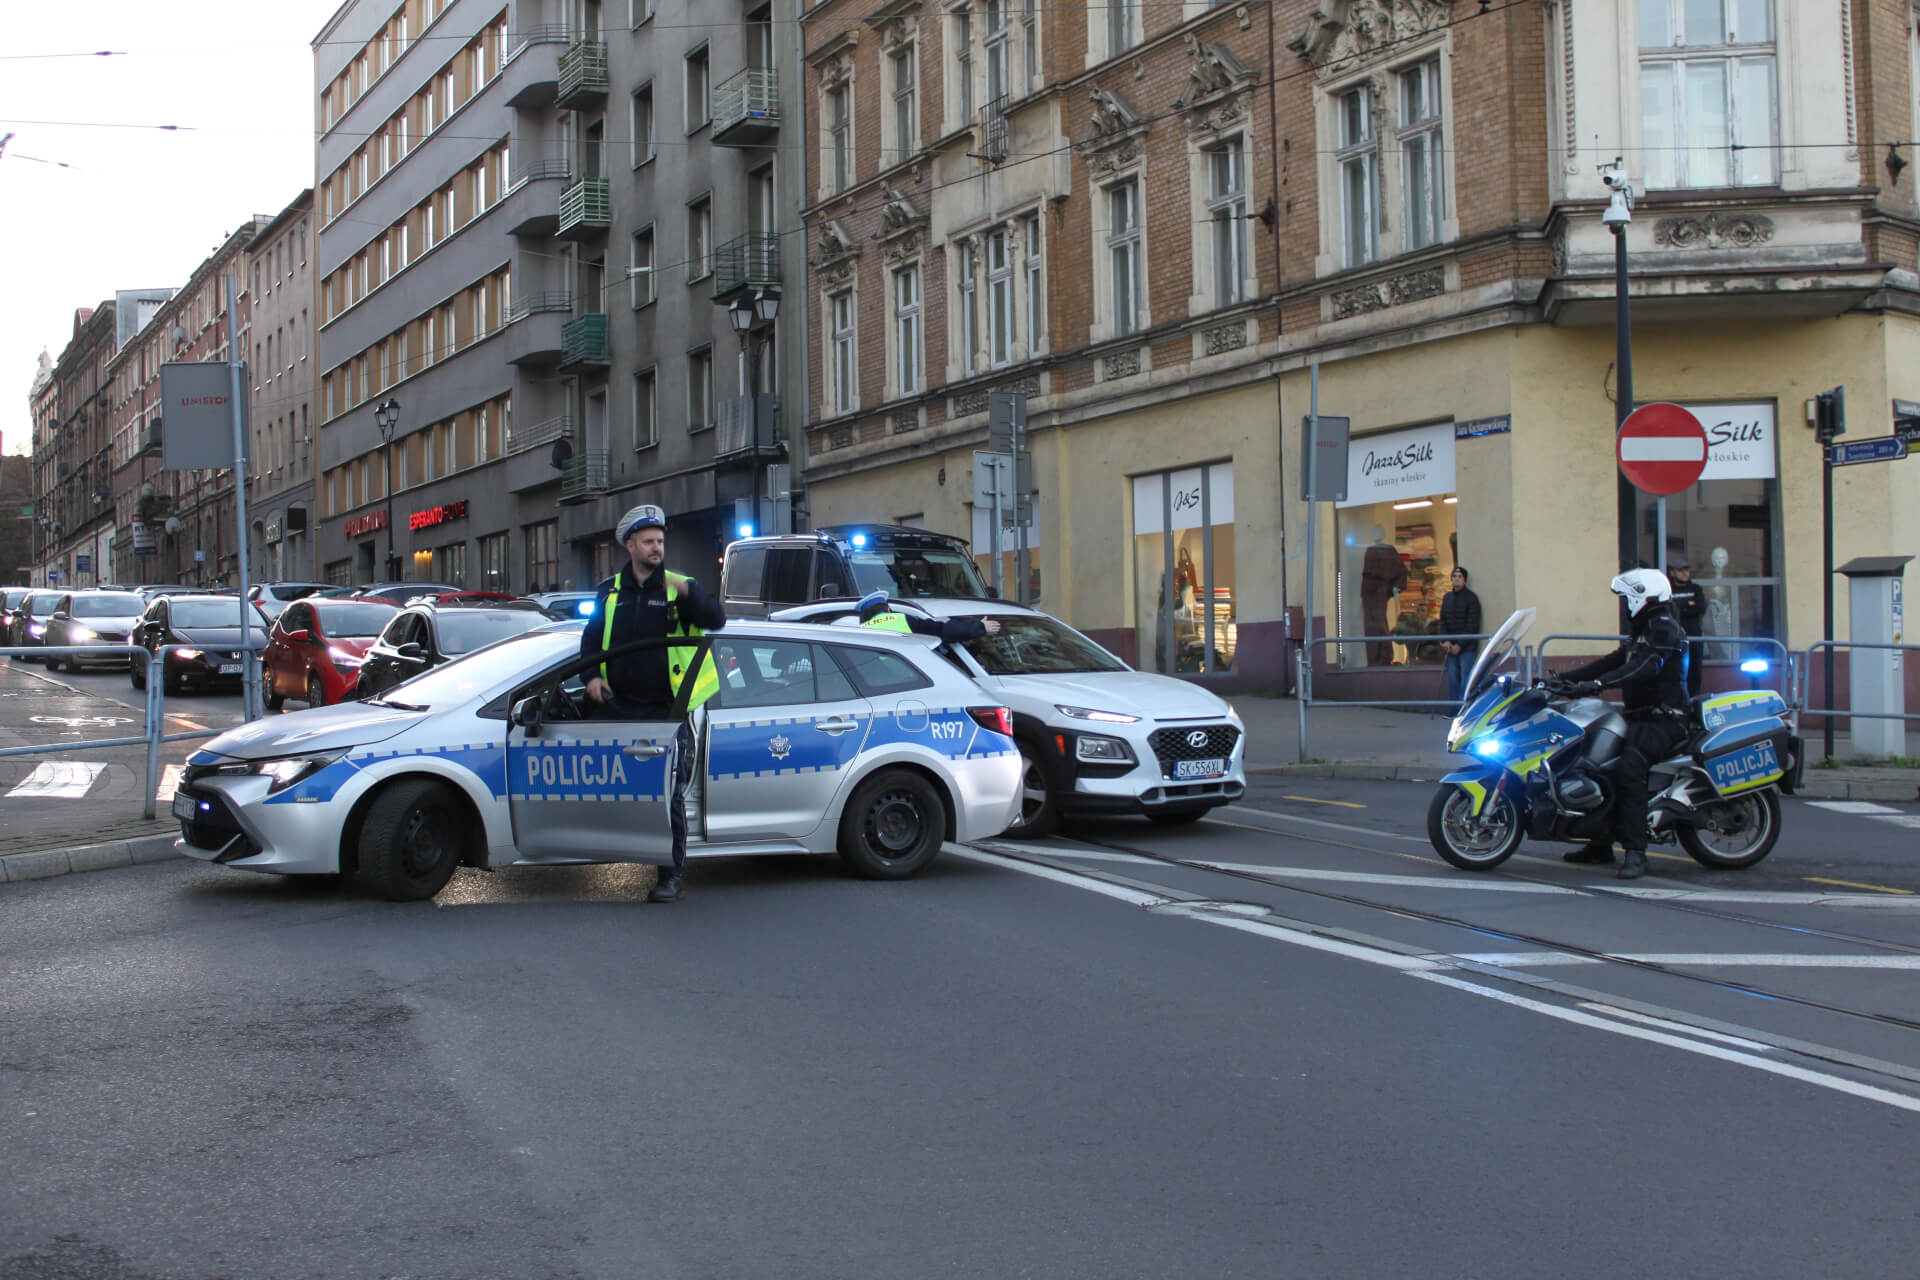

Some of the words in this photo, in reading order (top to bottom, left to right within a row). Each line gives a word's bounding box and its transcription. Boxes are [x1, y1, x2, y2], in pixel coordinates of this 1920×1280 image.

[1708, 421, 1762, 446] Silk
[1362, 441, 1432, 476] Jazz&Silk
[1173, 488, 1199, 511] J&S
[409, 507, 443, 530] ESPERANTO
[931, 721, 963, 739] R197
[527, 755, 628, 785] POLICJA
[1180, 762, 1191, 776] SK
[1195, 760, 1221, 774] 556XL
[1716, 750, 1774, 780] POLICJA
